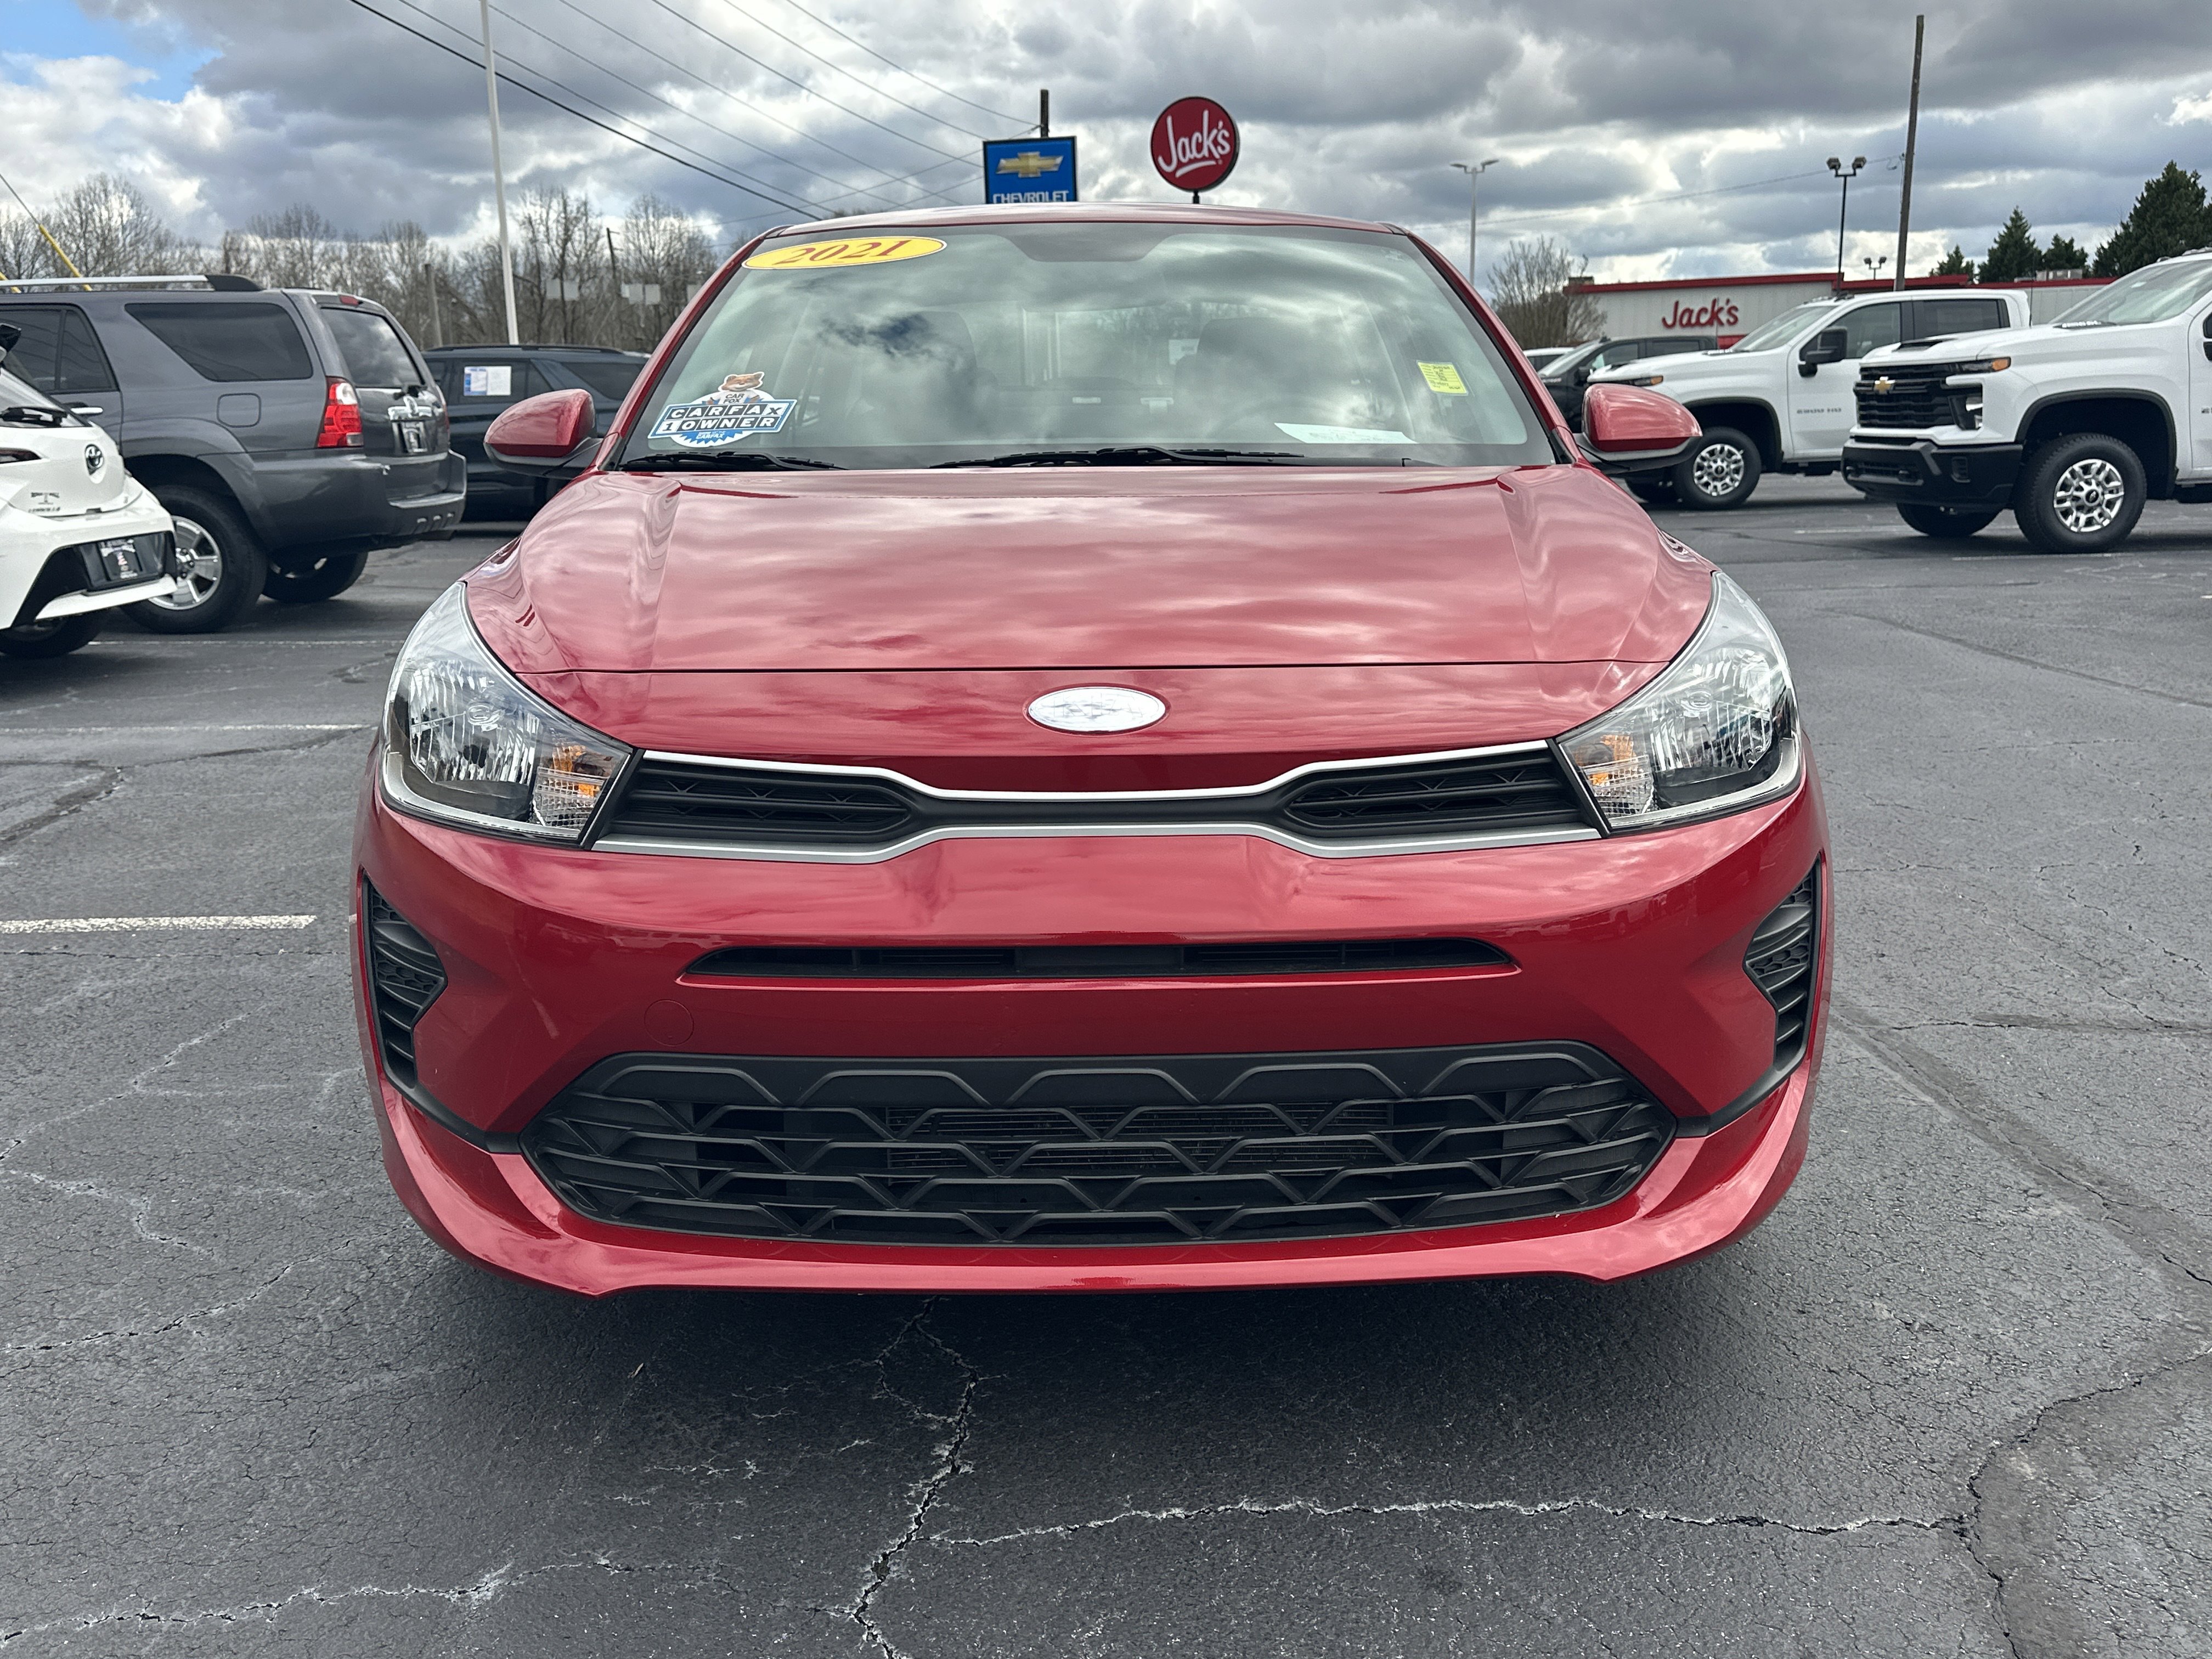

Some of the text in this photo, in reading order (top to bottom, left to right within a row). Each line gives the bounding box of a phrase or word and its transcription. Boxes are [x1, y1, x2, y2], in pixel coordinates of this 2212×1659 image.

[1158, 109, 1231, 173] Jack's
[992, 190, 1069, 204] CHEVROLET
[772, 239, 912, 266] 2021
[1662, 298, 1739, 329] Jack's
[671, 405, 782, 419] CARFAX
[662, 417, 775, 432] 1 OWNER
